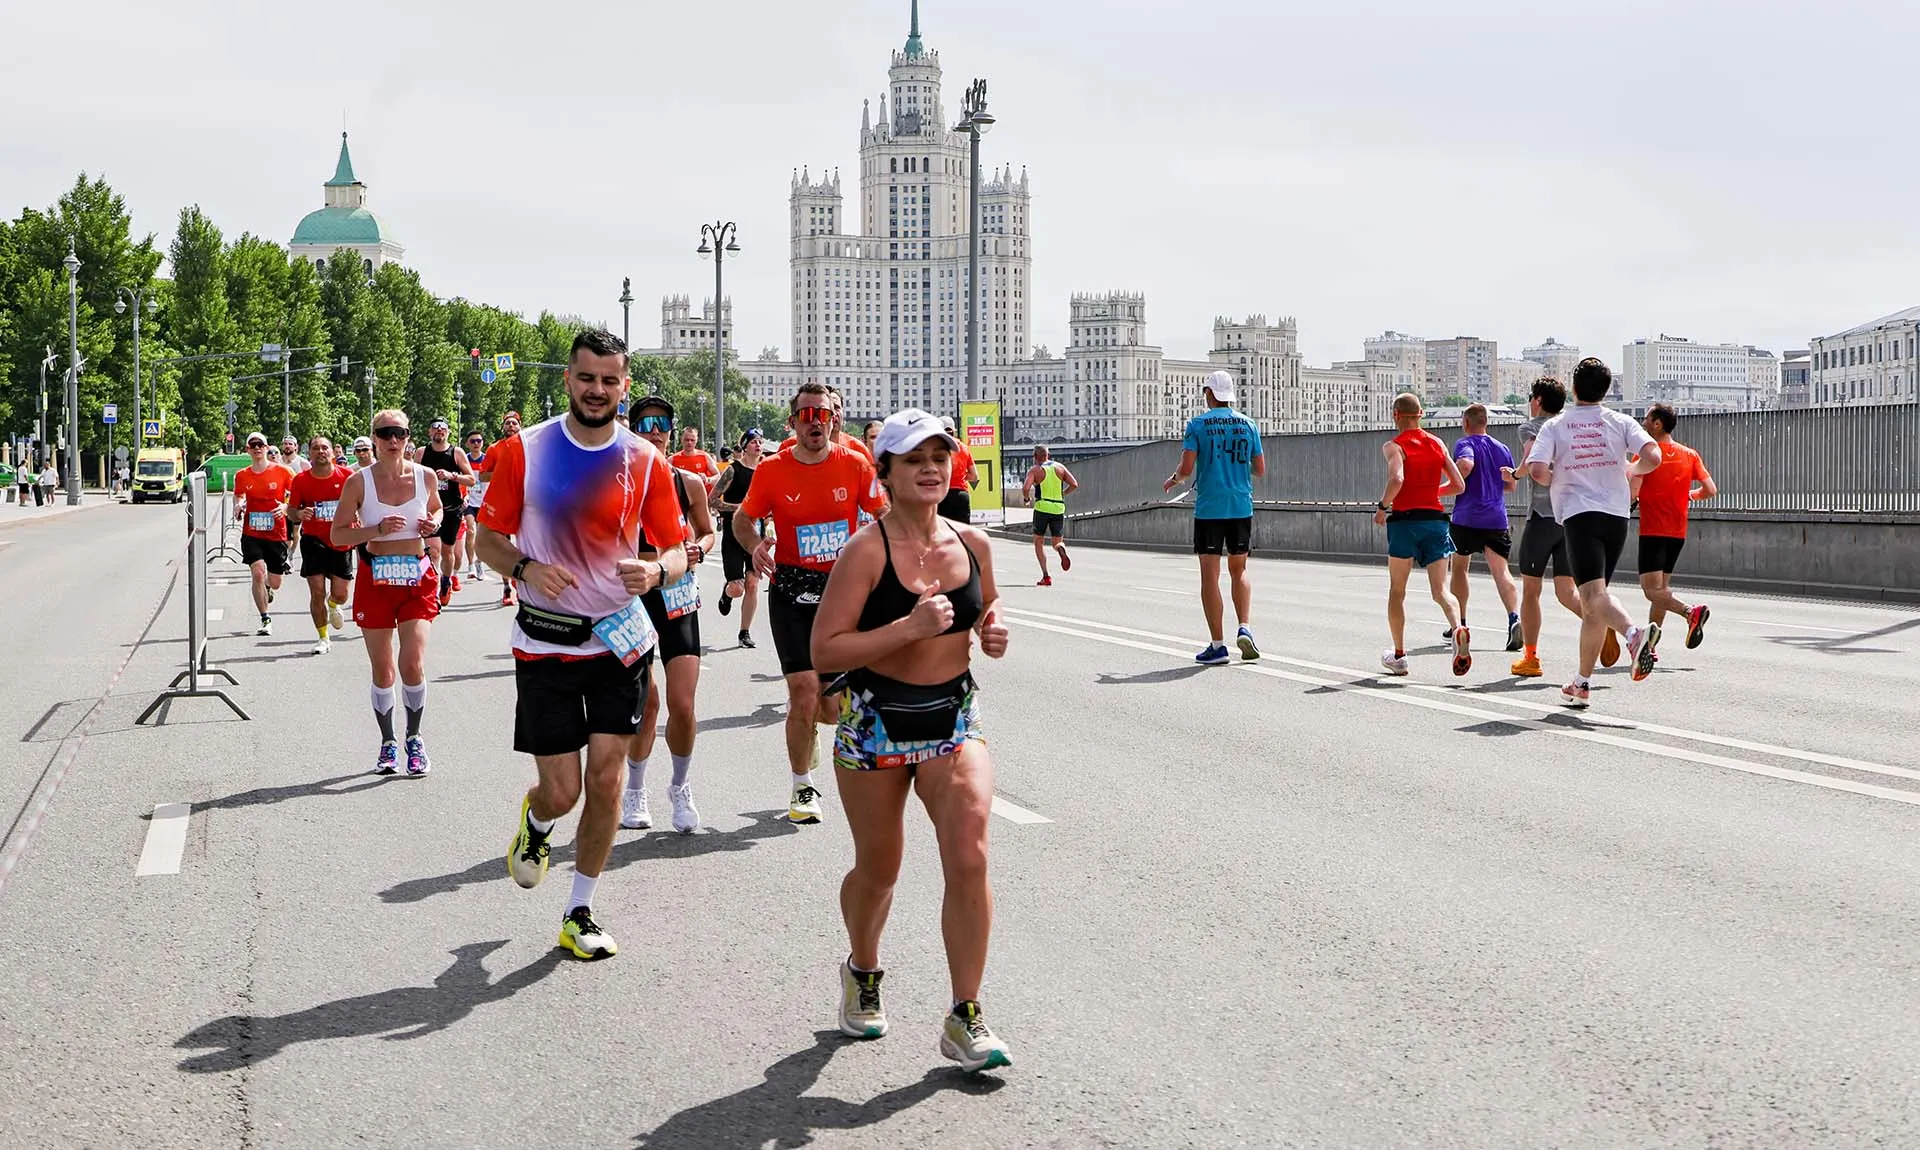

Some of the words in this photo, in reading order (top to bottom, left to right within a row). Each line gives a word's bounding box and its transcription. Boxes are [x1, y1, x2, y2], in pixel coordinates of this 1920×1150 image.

[1209, 438, 1249, 464] 1:40
[832, 487, 848, 502] 10
[801, 531, 846, 555] 72452
[374, 563, 418, 578] 70863
[532, 620, 573, 633] DEMIX
